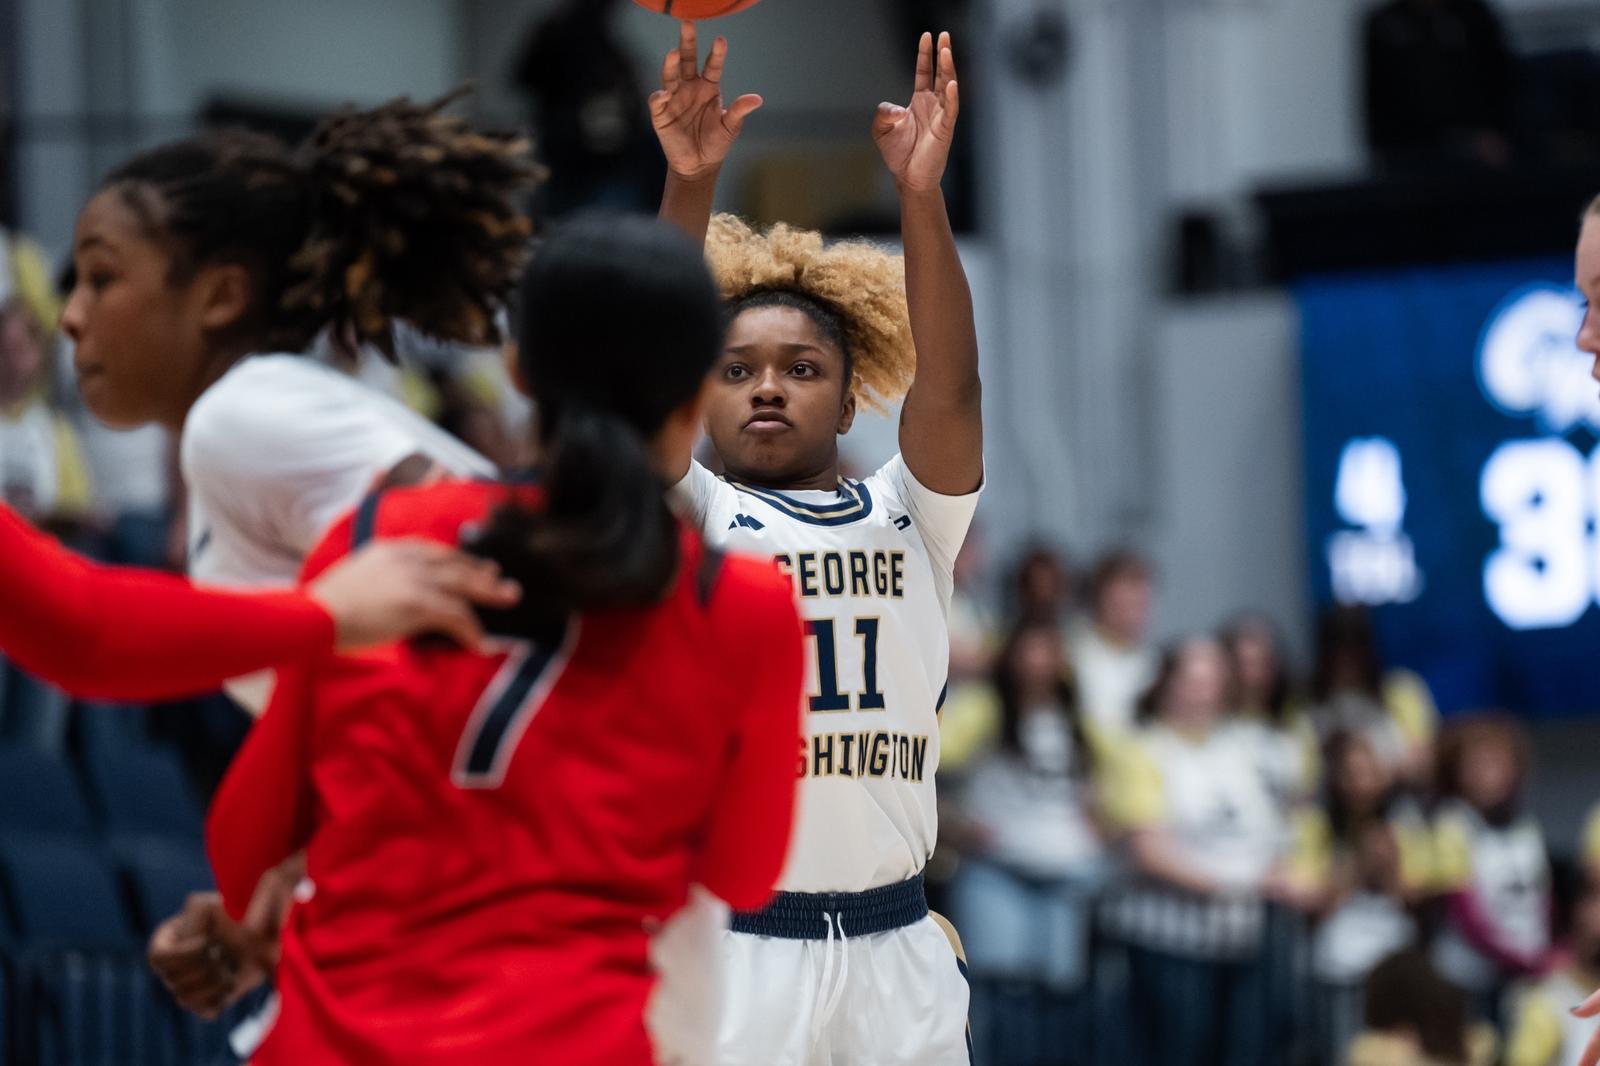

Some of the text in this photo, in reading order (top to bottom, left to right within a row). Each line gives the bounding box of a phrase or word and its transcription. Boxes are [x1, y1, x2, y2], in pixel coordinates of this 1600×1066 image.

[1480, 437, 1600, 630] 3
[450, 608, 582, 789] 7
[802, 615, 886, 713] 11
[796, 731, 928, 783] HINGTON
